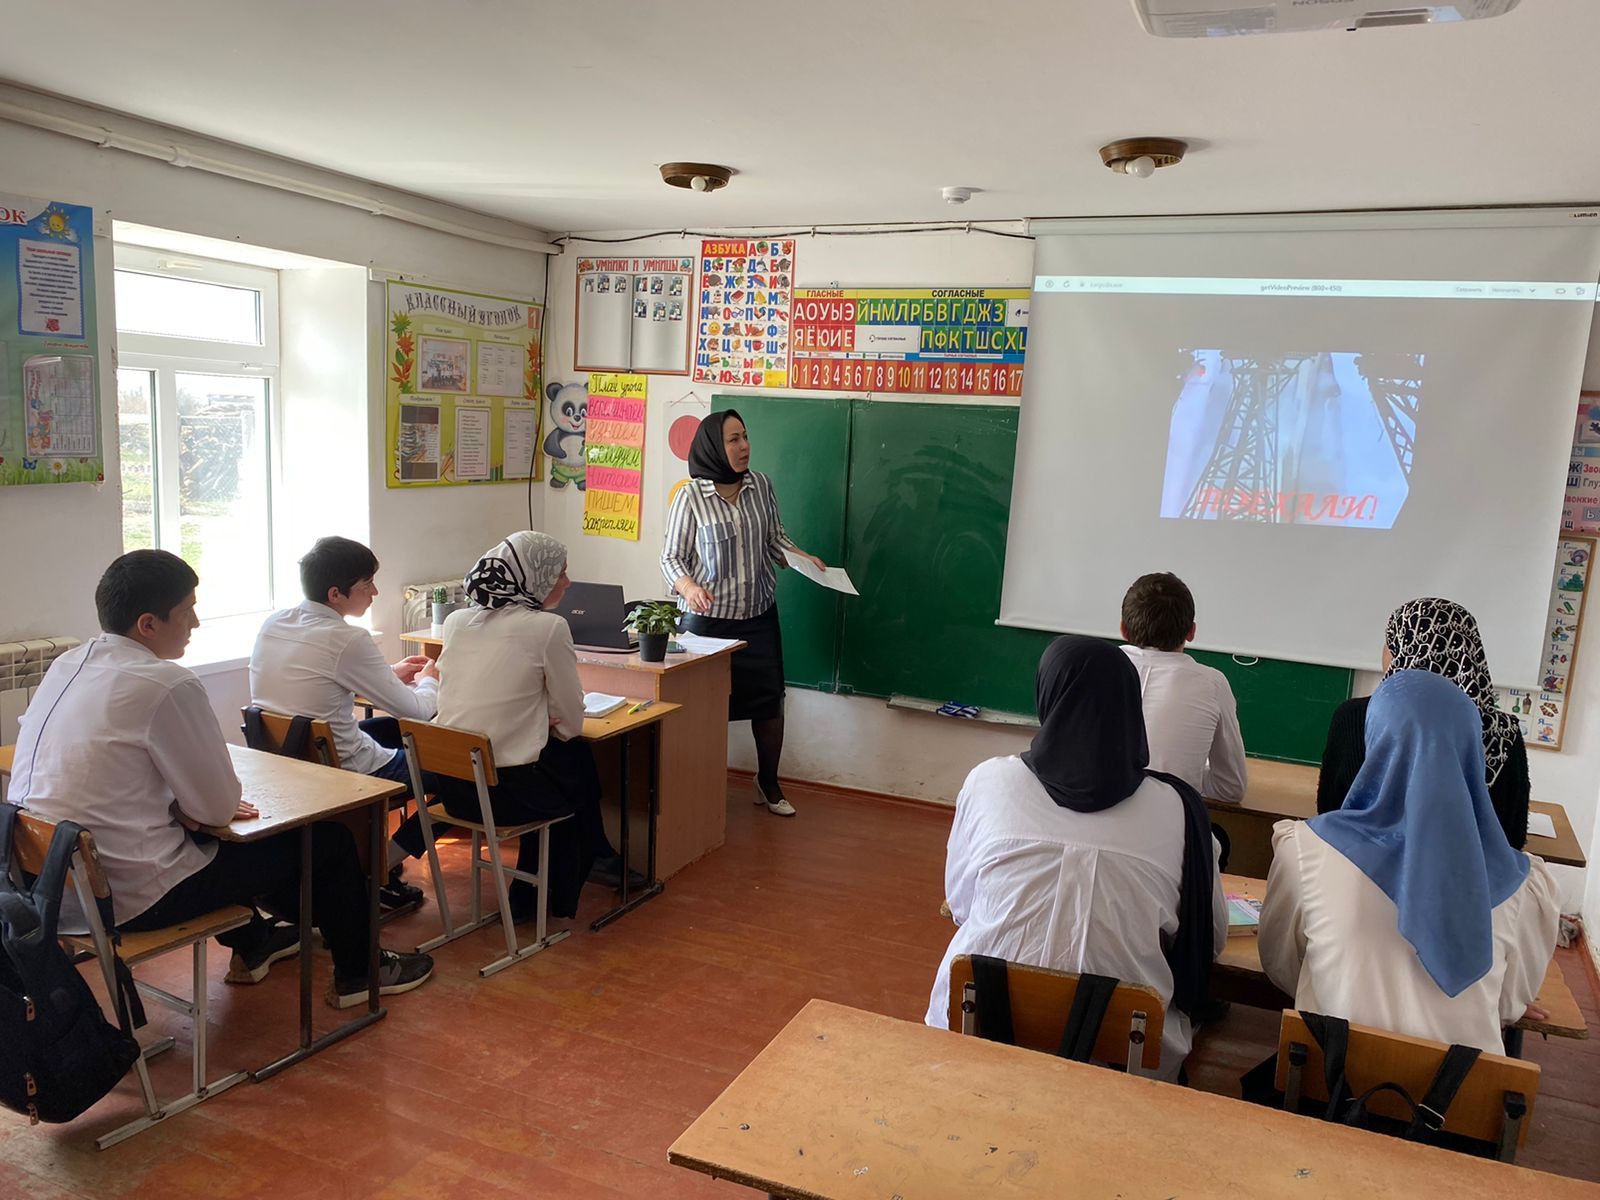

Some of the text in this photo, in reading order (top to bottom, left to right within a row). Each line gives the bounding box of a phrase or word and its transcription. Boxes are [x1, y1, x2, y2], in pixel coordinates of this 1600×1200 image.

[704, 243, 746, 255] АЗБУКА
[749, 243, 779, 256] А Б
[596, 260, 628, 272] УМНИКИ
[643, 260, 678, 272] УМНИЦЫ
[703, 259, 711, 273] В
[726, 259, 732, 273] Г
[747, 259, 757, 273] Д
[724, 276, 736, 289] Ж
[747, 276, 754, 289] З
[769, 276, 778, 289] И
[702, 289, 779, 305] Й К Л М
[806, 290, 844, 298] ГЛАСНЫЕ
[931, 289, 985, 298] СОГЛАСНЫЕ
[405, 292, 476, 324] КЛАССНЫЙ
[723, 307, 731, 320] О
[746, 307, 753, 321] П
[768, 307, 776, 321] Р
[700, 322, 707, 335] С
[767, 324, 778, 337] Ф
[699, 338, 778, 354] Х Ц Ч Ш
[697, 353, 710, 367] Щ
[720, 370, 732, 383] Ю
[743, 371, 751, 384] Я
[792, 363, 1024, 391] 0 1 2 3 4 5 6 7 8 9 10 11 12 13 14 15 16 17
[587, 490, 635, 513] ПИШЕМ
[1564, 494, 1599, 505] вонкие
